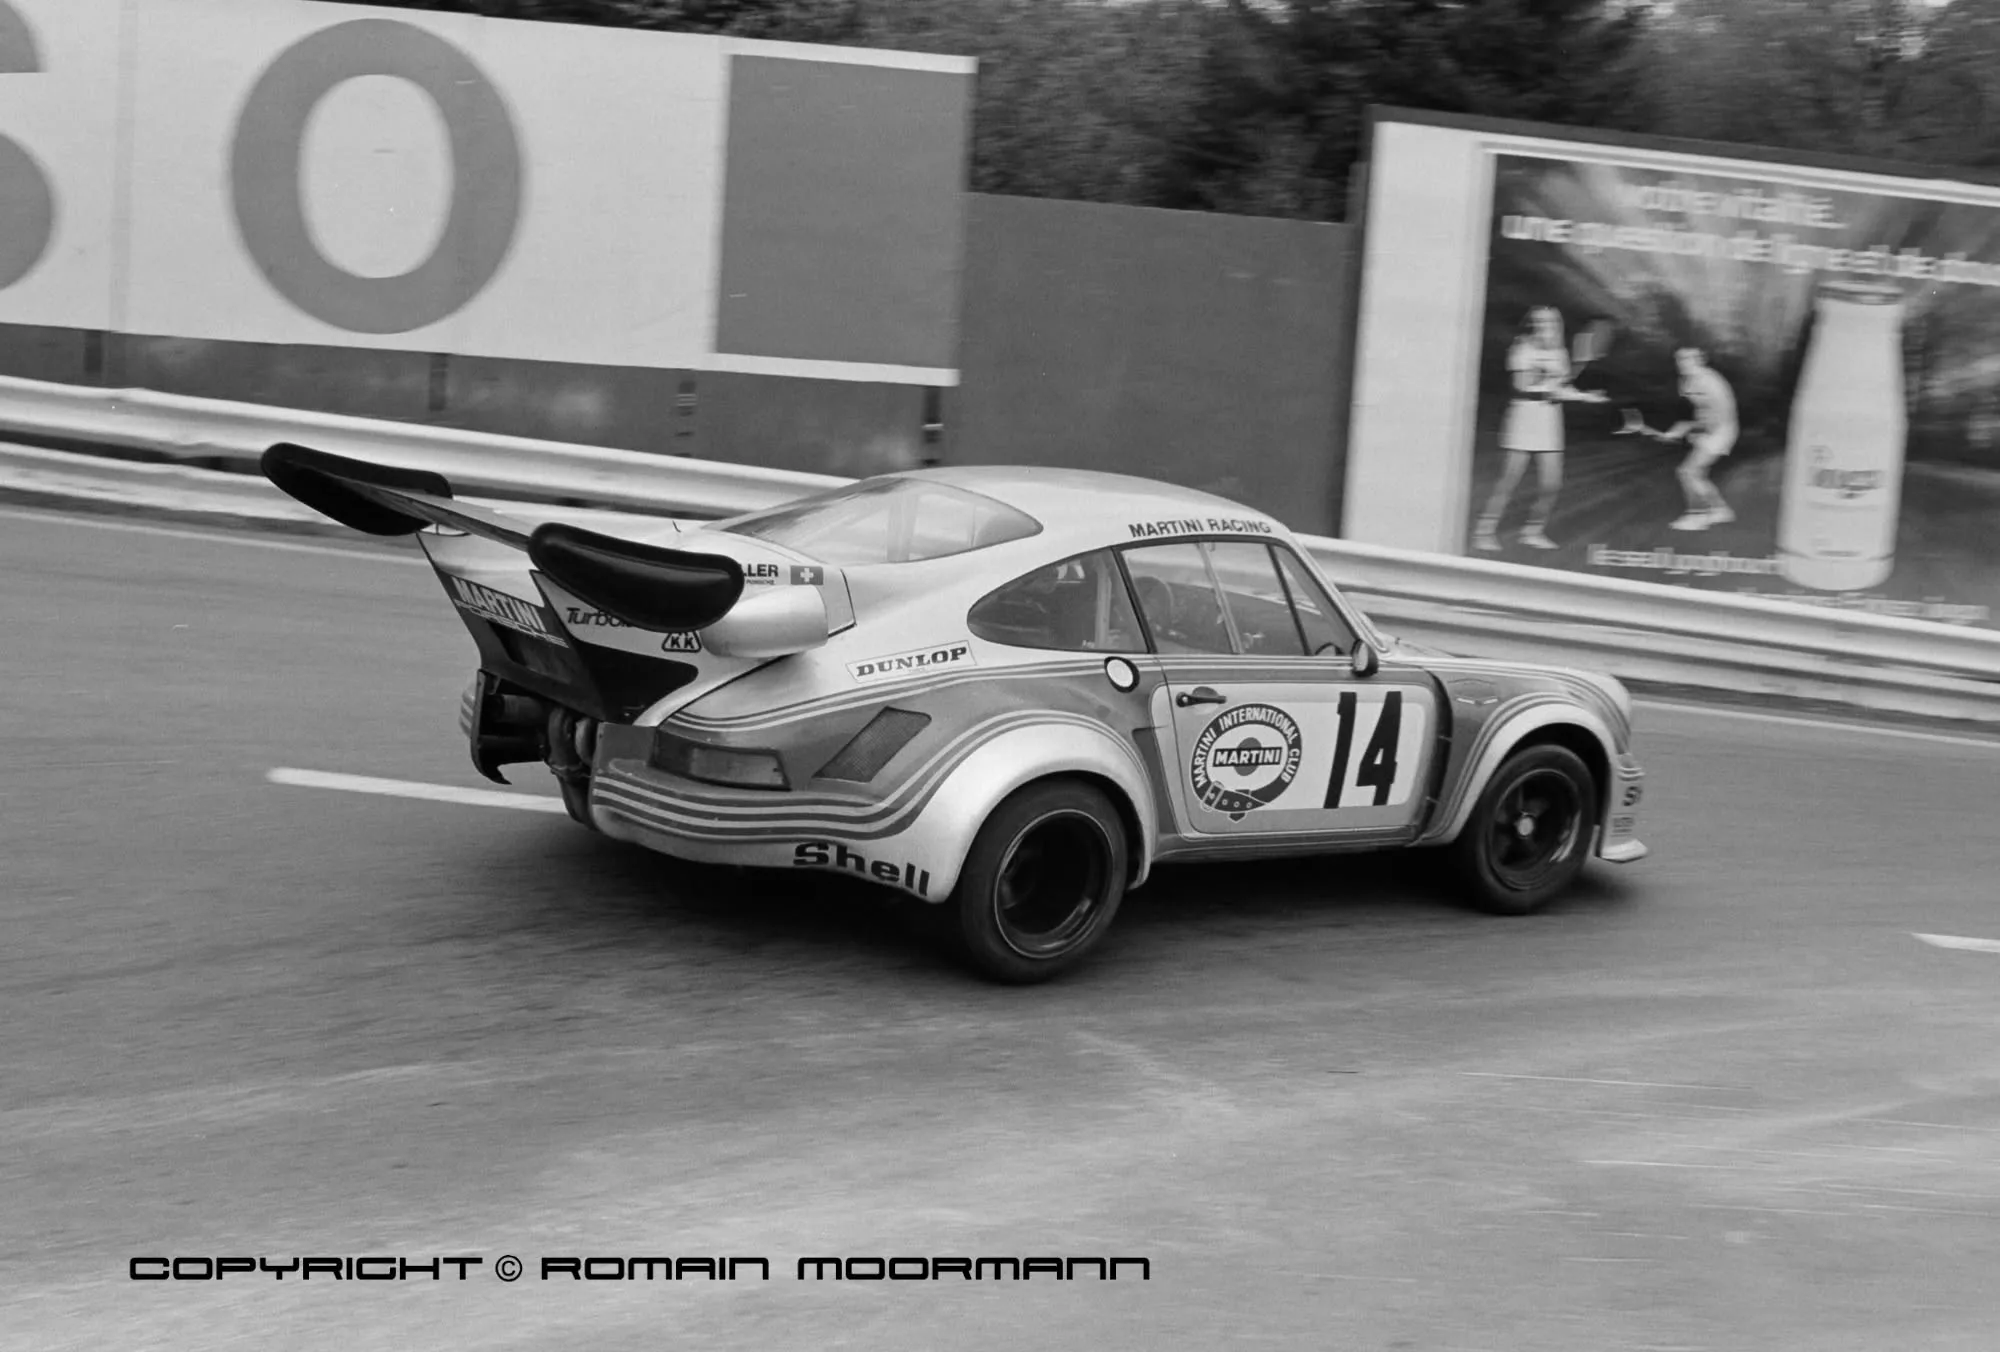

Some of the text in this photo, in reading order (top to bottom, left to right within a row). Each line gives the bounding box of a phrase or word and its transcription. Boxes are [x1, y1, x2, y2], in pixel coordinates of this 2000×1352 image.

[1128, 518, 1272, 538] MARTINI RACING
[452, 576, 547, 633] MARTINI
[566, 606, 634, 628] Turbo
[856, 646, 967, 677] DUNLOP
[1193, 707, 1300, 788] MARTINI INTERNATIONAL CLUB
[1215, 749, 1281, 765] MARTINI
[1323, 691, 1402, 809] 14
[793, 842, 930, 897] Shell
